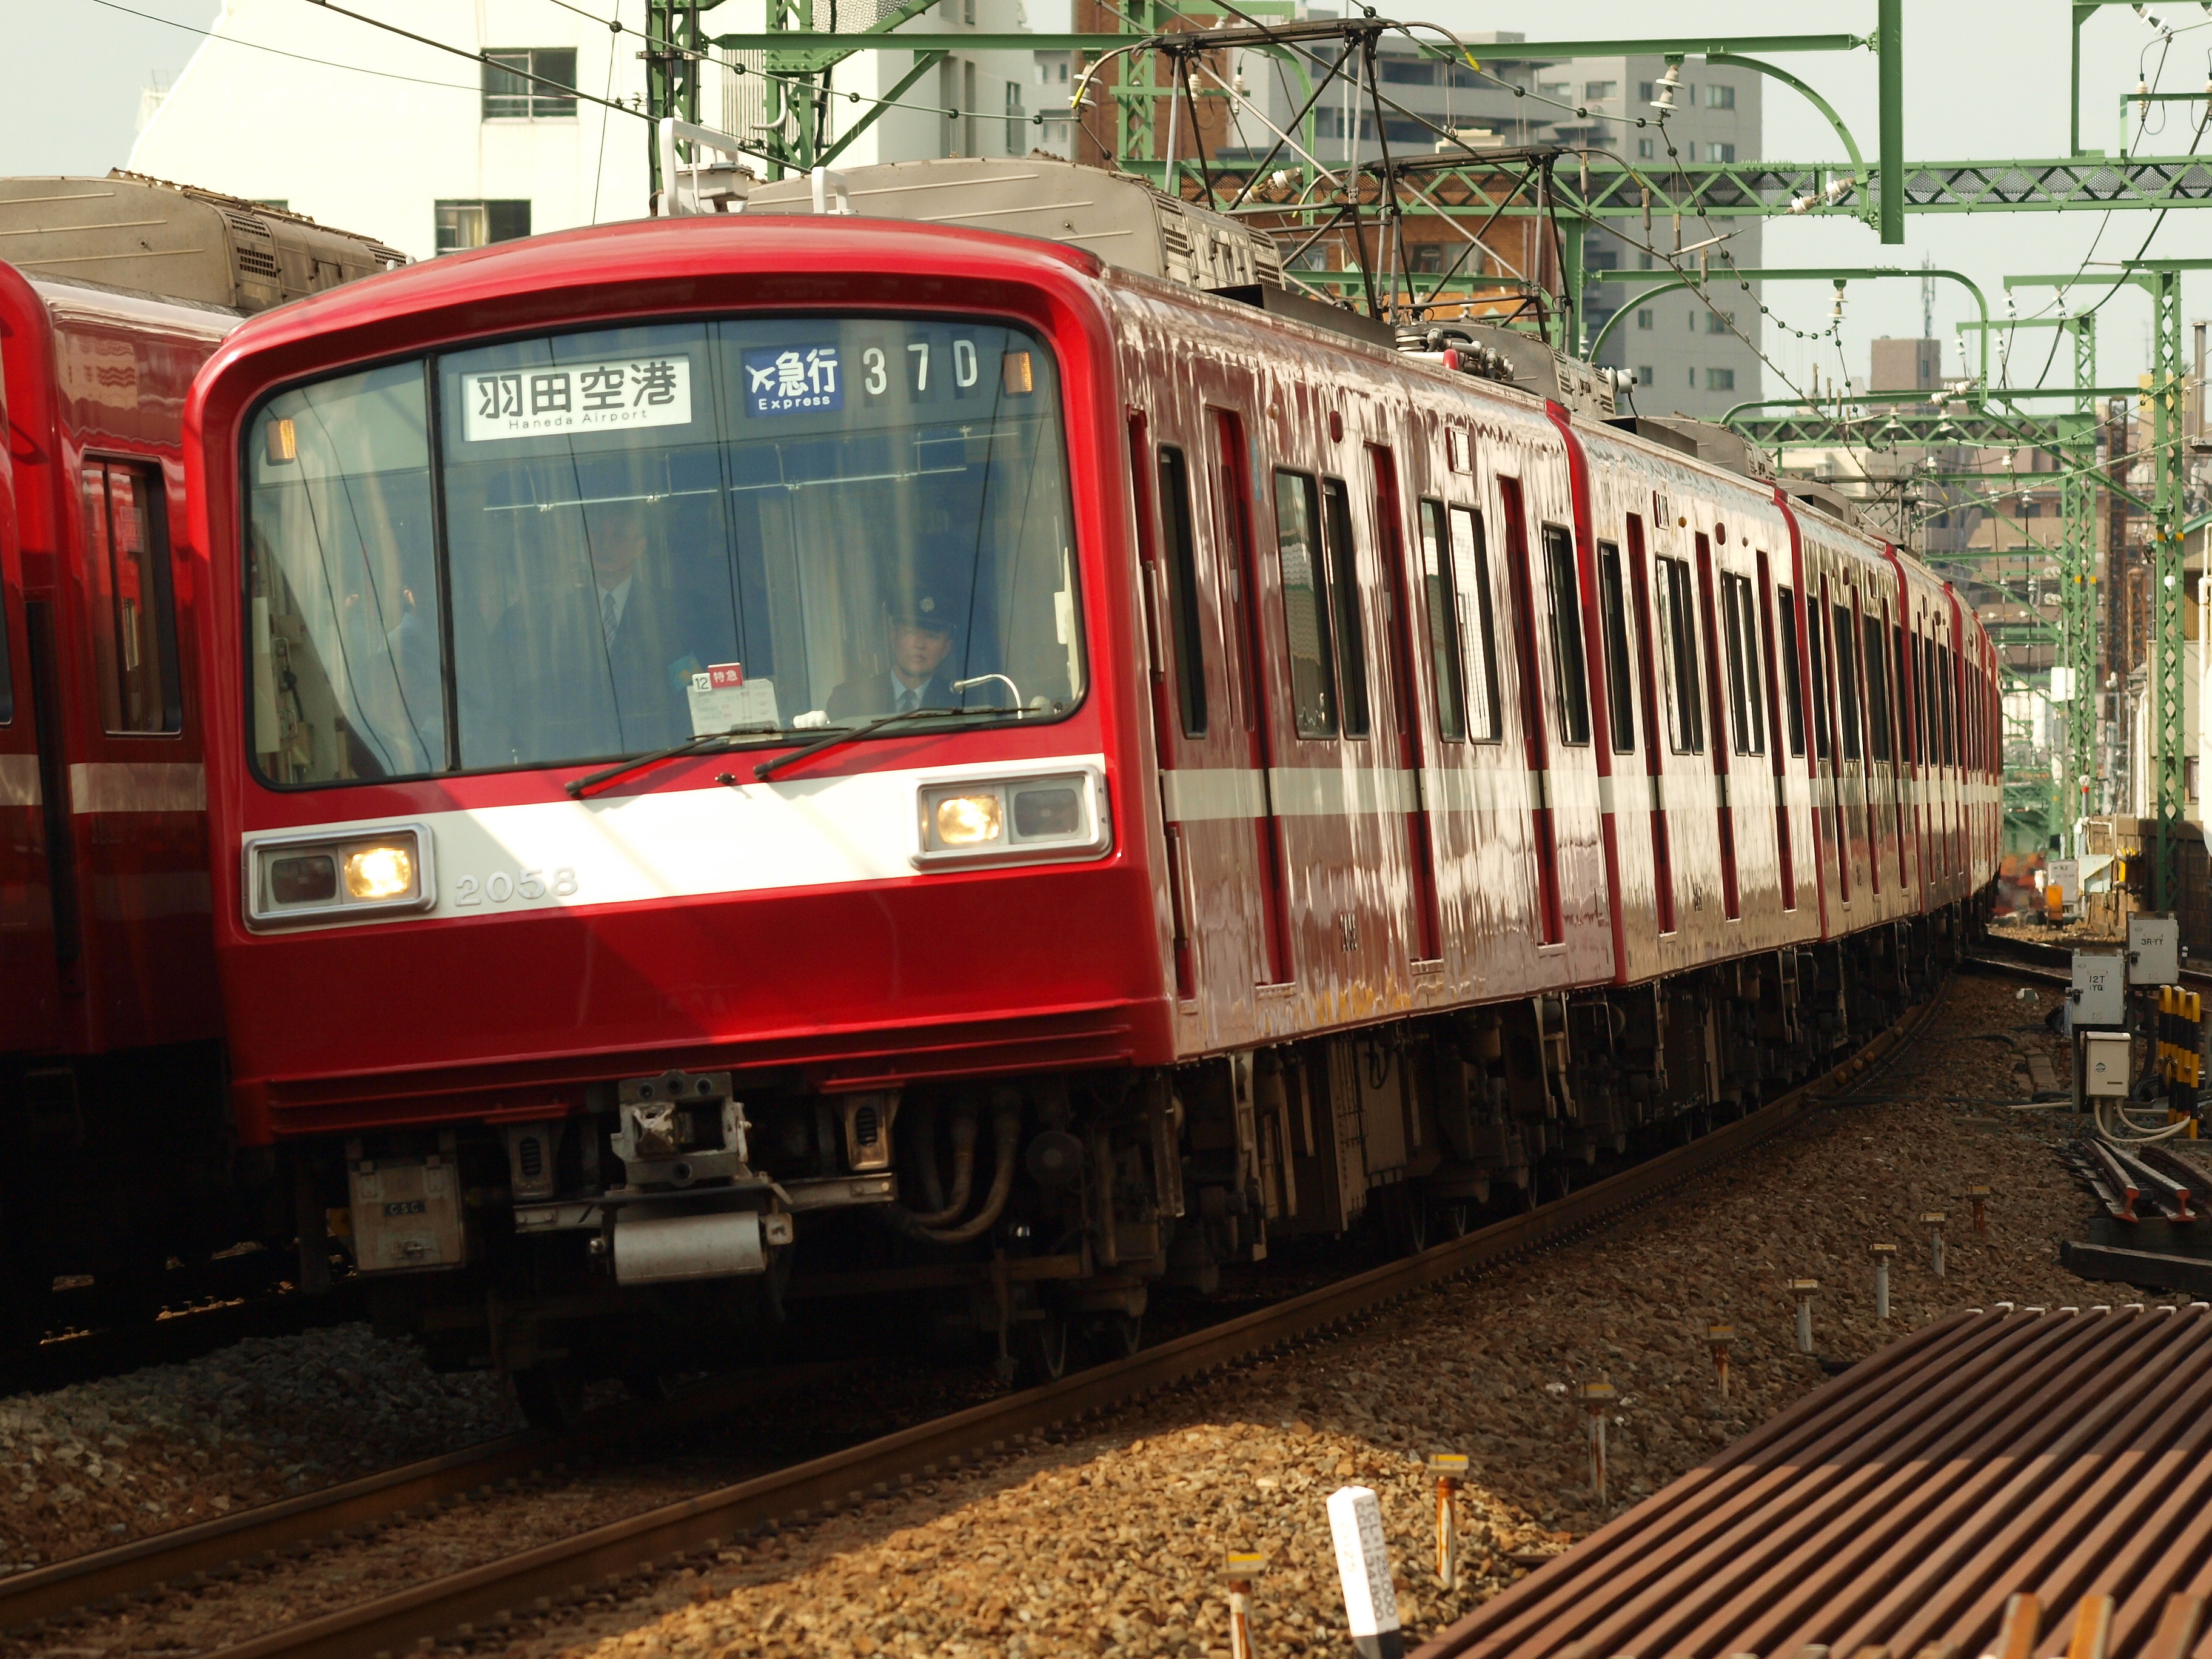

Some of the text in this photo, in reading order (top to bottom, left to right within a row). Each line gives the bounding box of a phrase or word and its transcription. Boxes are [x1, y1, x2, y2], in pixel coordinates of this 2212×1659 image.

[776, 348, 838, 397] 急行
[477, 361, 677, 419] 羽田空港
[758, 395, 831, 411] Express
[509, 409, 648, 430] Haneda Airport
[695, 677, 709, 690] 12
[456, 866, 578, 907] 2058
[2089, 975, 2106, 984] 12T
